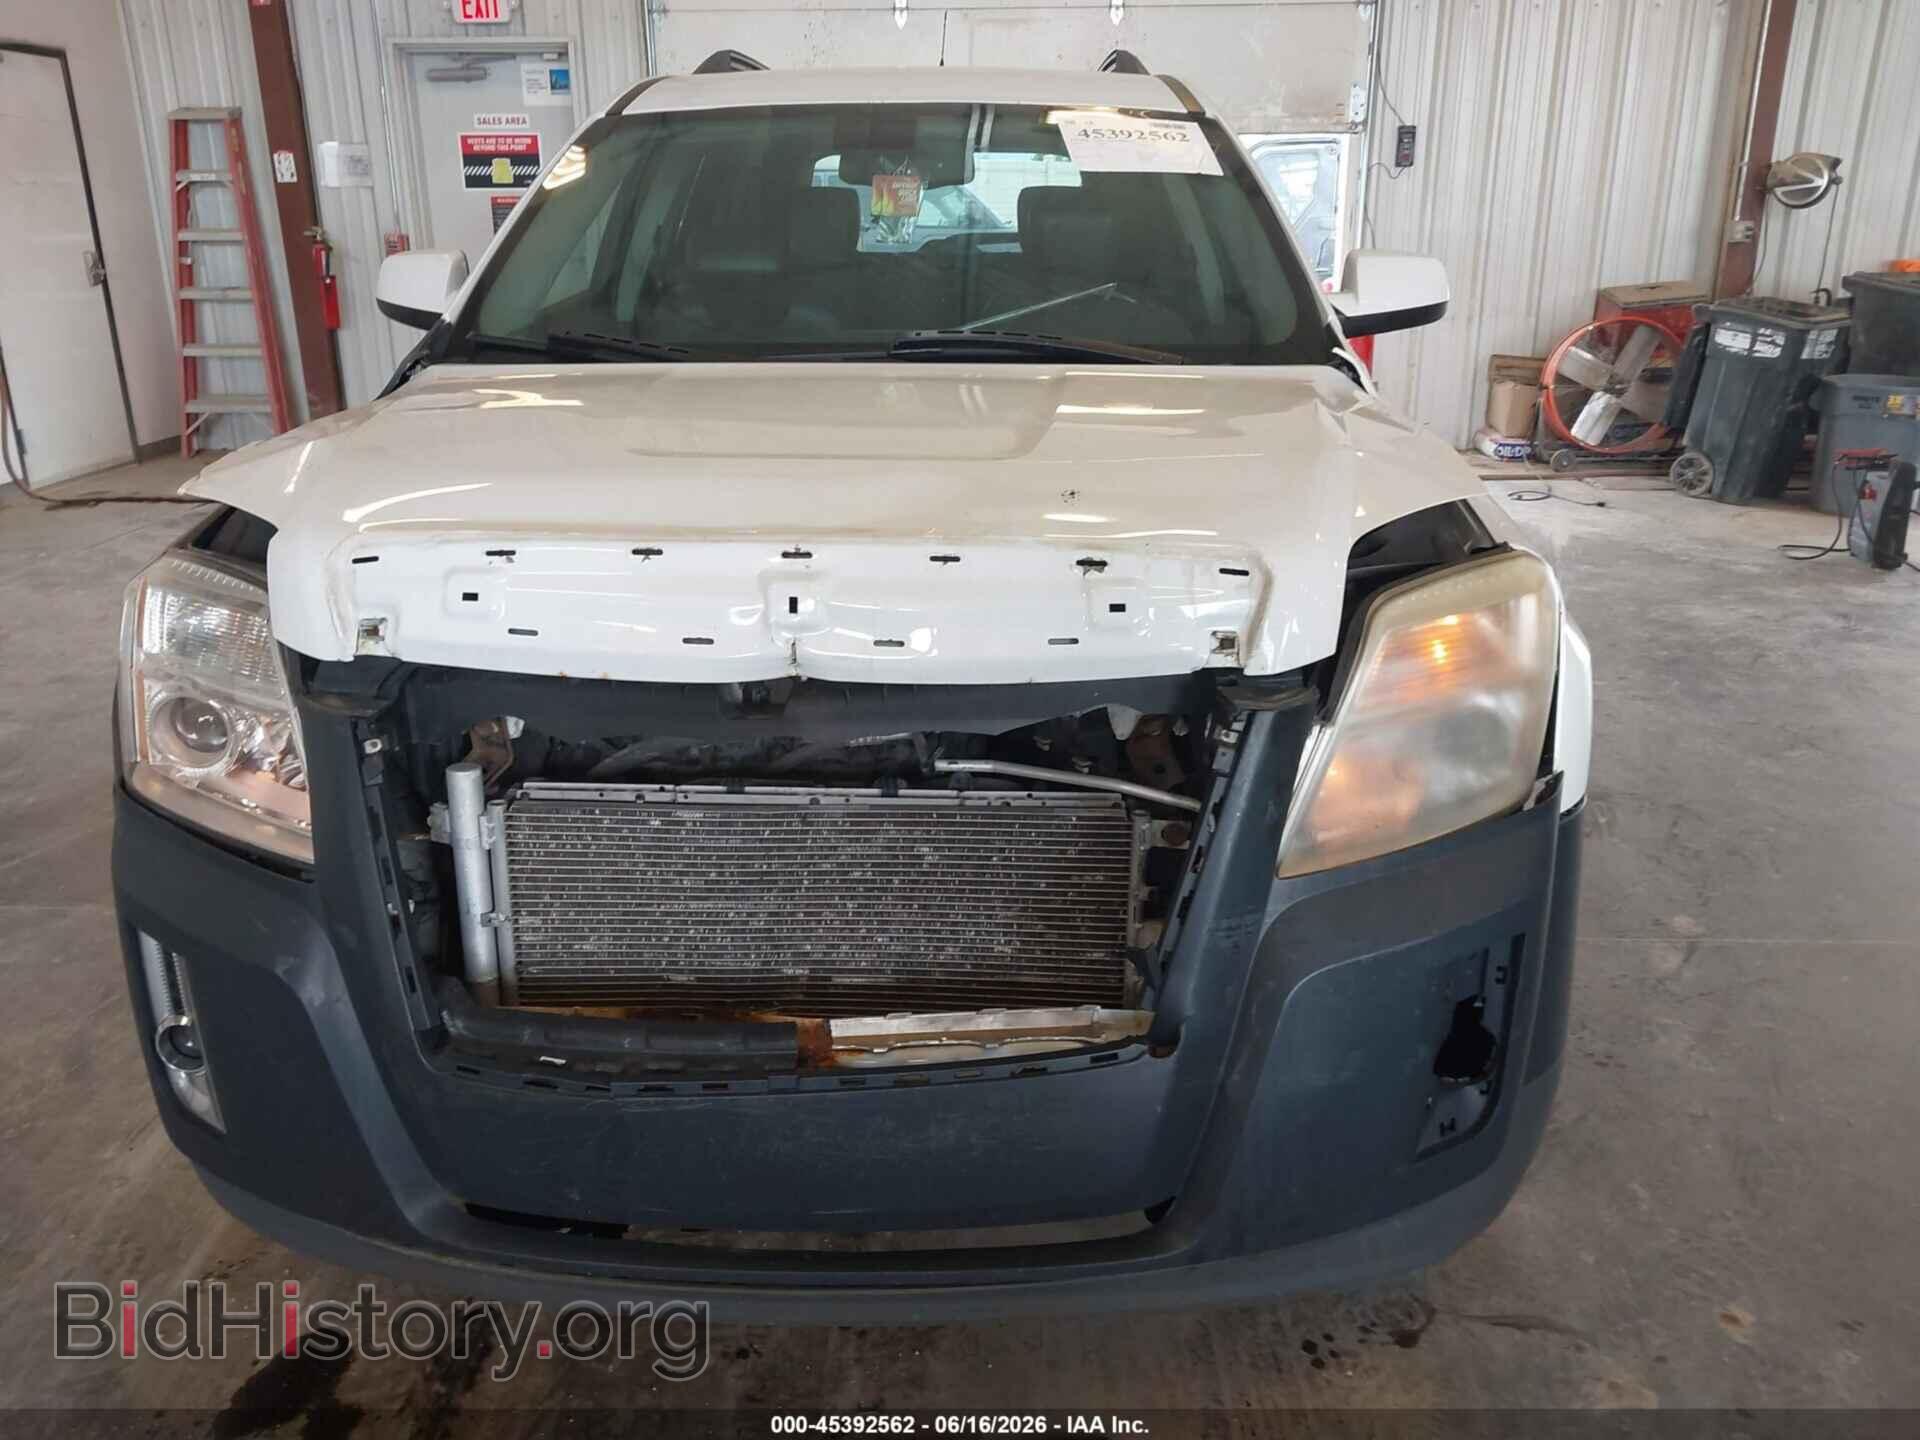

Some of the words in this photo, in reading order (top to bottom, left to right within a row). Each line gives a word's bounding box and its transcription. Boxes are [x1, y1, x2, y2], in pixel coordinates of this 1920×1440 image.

[462, 0, 498, 18] EXIT
[477, 116, 502, 126] SALES
[505, 116, 527, 126] AREA
[1077, 127, 1191, 143] 45392562
